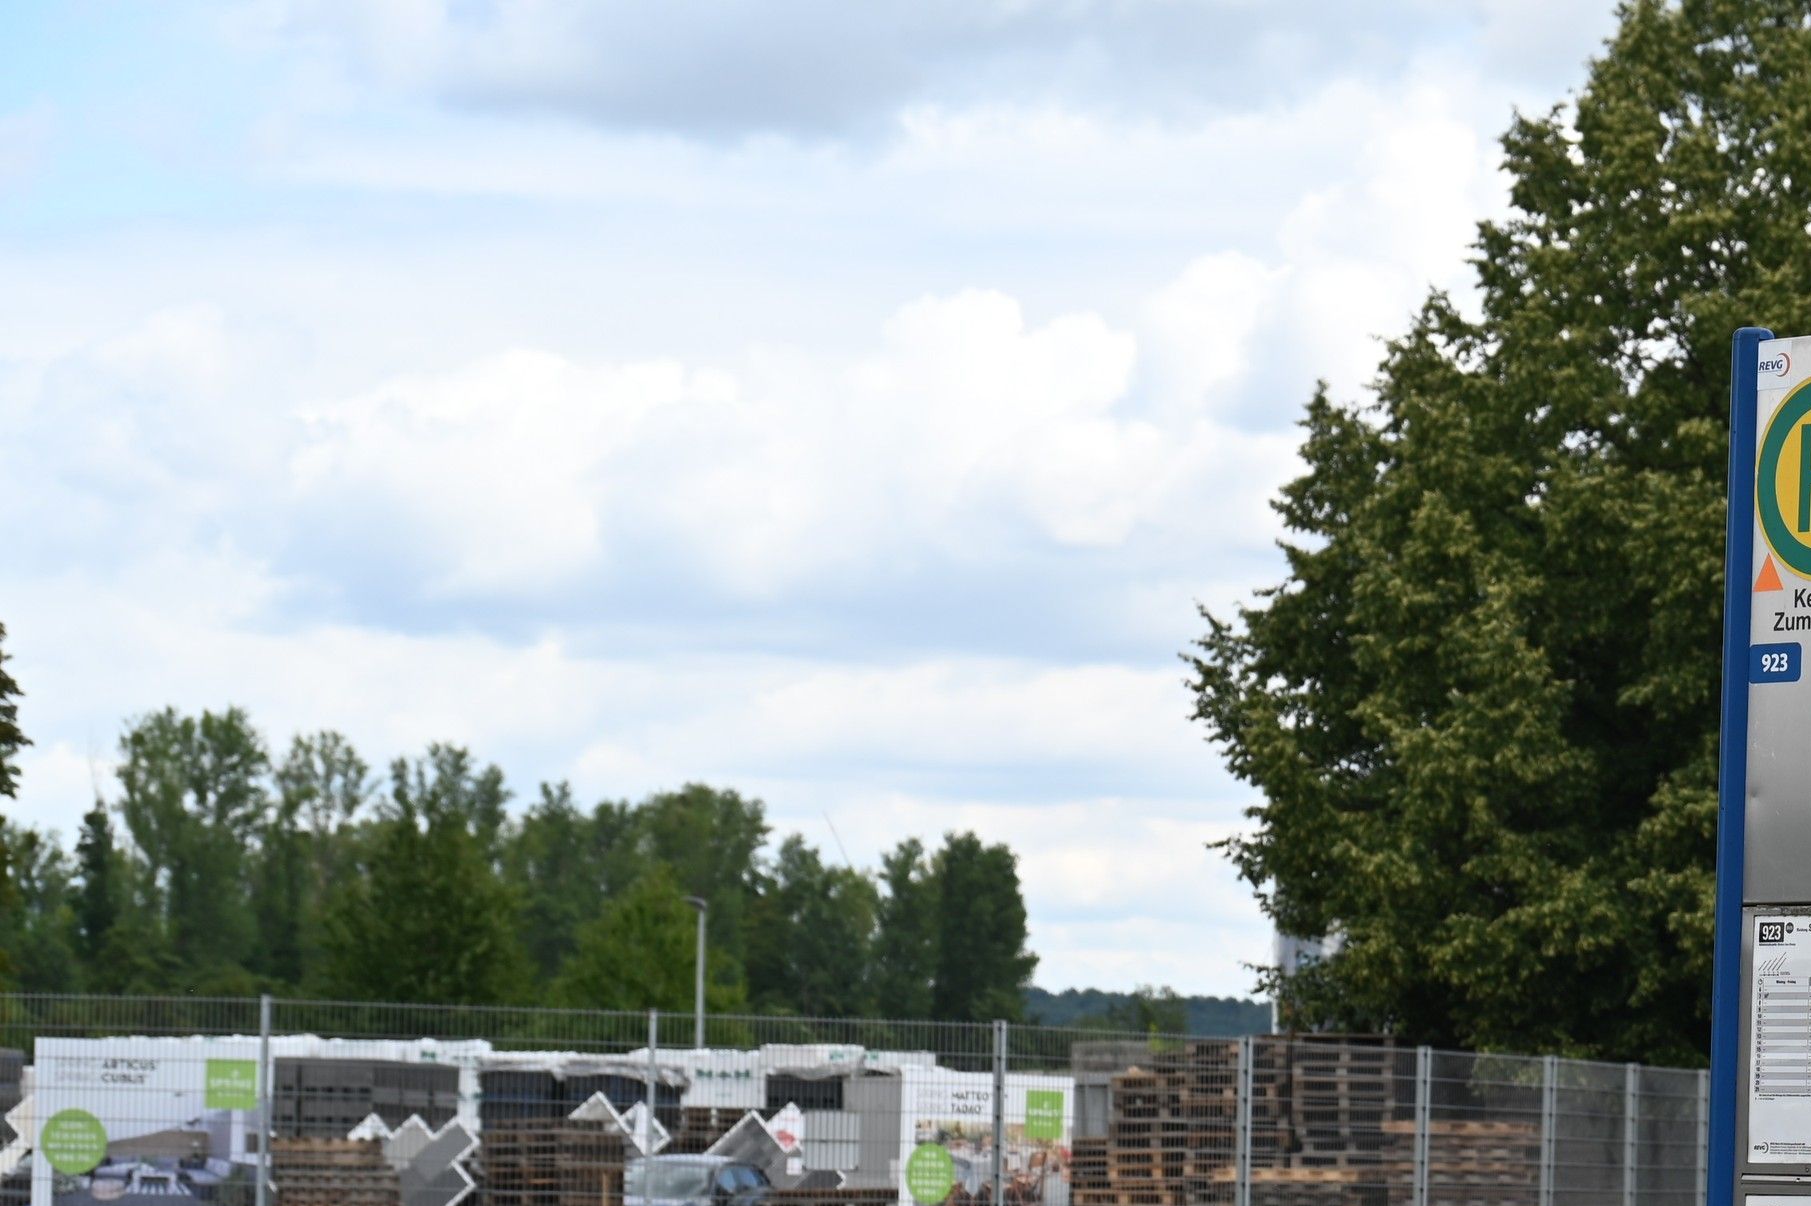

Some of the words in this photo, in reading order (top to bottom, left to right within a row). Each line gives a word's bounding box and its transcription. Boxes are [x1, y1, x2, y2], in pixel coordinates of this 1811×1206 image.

[1758, 359, 1783, 371] REVG
[1773, 611, 1811, 632] Zum
[1761, 653, 1788, 673] 923
[1762, 925, 1781, 941] 923
